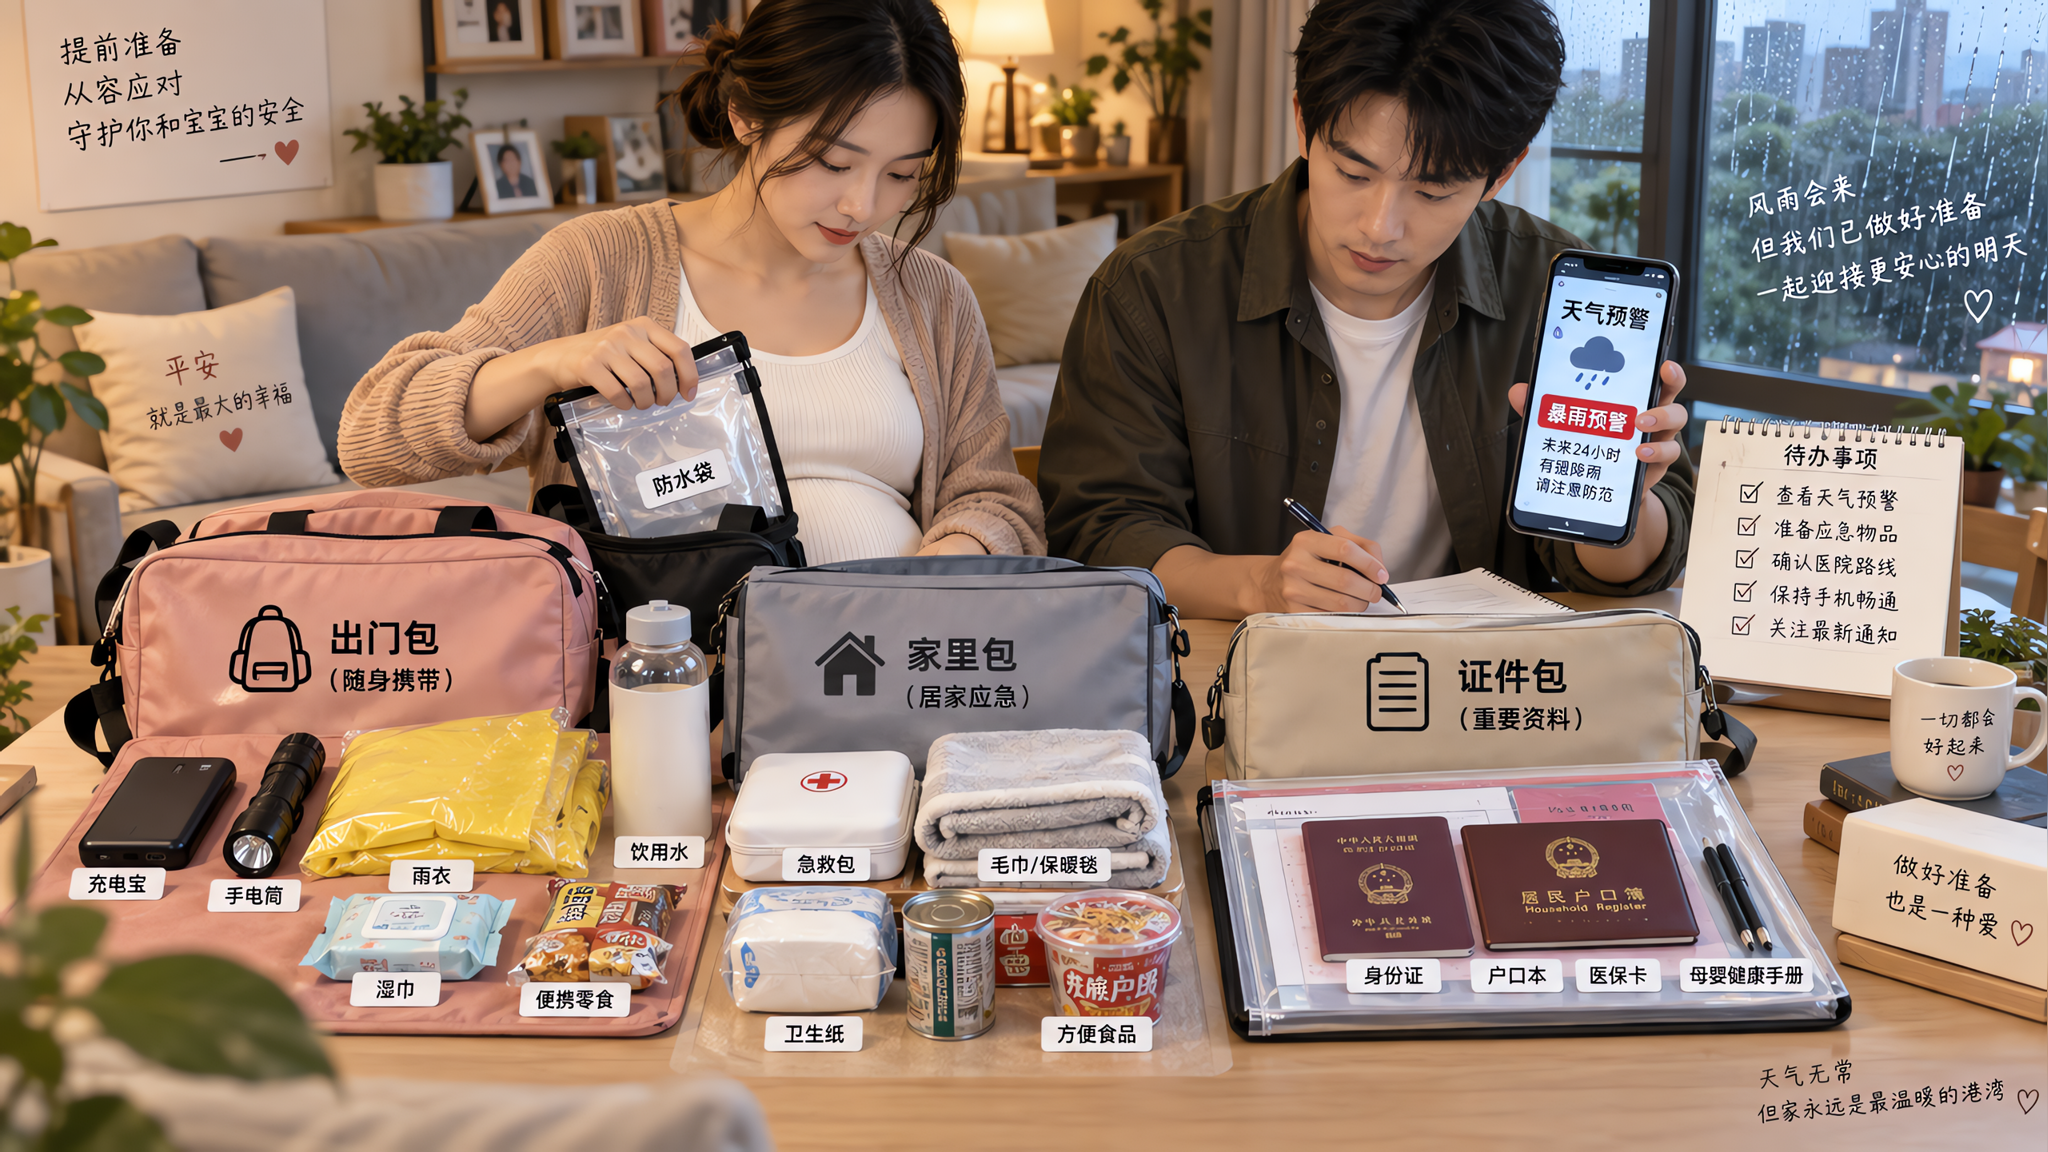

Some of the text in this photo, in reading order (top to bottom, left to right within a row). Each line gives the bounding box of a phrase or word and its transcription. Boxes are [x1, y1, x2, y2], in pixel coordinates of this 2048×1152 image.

[61, 28, 181, 65] 提前准备
[64, 70, 182, 105] 从容应对
[67, 96, 304, 152] 守护你和宝宝的安全
[1561, 300, 1649, 331] 天气预警
[165, 350, 220, 387] 平安
[147, 382, 291, 431] 就是最大的幸福
[1547, 402, 1628, 433] 暴雨预警
[1540, 437, 1621, 463] 未来24小时
[1784, 444, 1877, 469] 待办事项
[653, 462, 716, 497] 防水袋
[1777, 485, 1898, 511] 查看天气预警
[1775, 519, 1897, 542] 准备应急物品
[1772, 552, 1896, 577] 确认医院路线
[1771, 585, 1898, 611] 保持手机畅通
[332, 620, 438, 655] 出门包
[1770, 618, 1897, 644] 关注最新通知
[908, 637, 1017, 671] 家里包
[331, 668, 451, 692] （随身携带）
[1458, 659, 1567, 693] 证件包
[907, 684, 1028, 709] （居家应急）
[1461, 707, 1581, 731] （重要资料）
[1921, 708, 1995, 729] 一切都会
[1924, 736, 1984, 755] 好起来
[631, 843, 688, 861] 饮用水
[798, 855, 855, 873] 急救包
[991, 855, 1097, 874] 毛巾/保暖毯
[88, 874, 146, 893] 充电宝
[413, 866, 450, 885] 雨衣
[1893, 855, 1996, 900] 做好准备
[225, 886, 283, 905] 手电筒
[1886, 890, 1997, 939] 也是一种爱
[1365, 966, 1423, 985] 身份证
[1489, 966, 1546, 984] 户口本
[1590, 966, 1647, 985] 医保卡
[1690, 966, 1803, 985] 母婴健康手册
[377, 980, 414, 999] 湿巾
[536, 990, 614, 1009] 便携零食
[785, 1024, 844, 1043] 卫生纸
[1058, 1024, 1135, 1043] 方便食品
